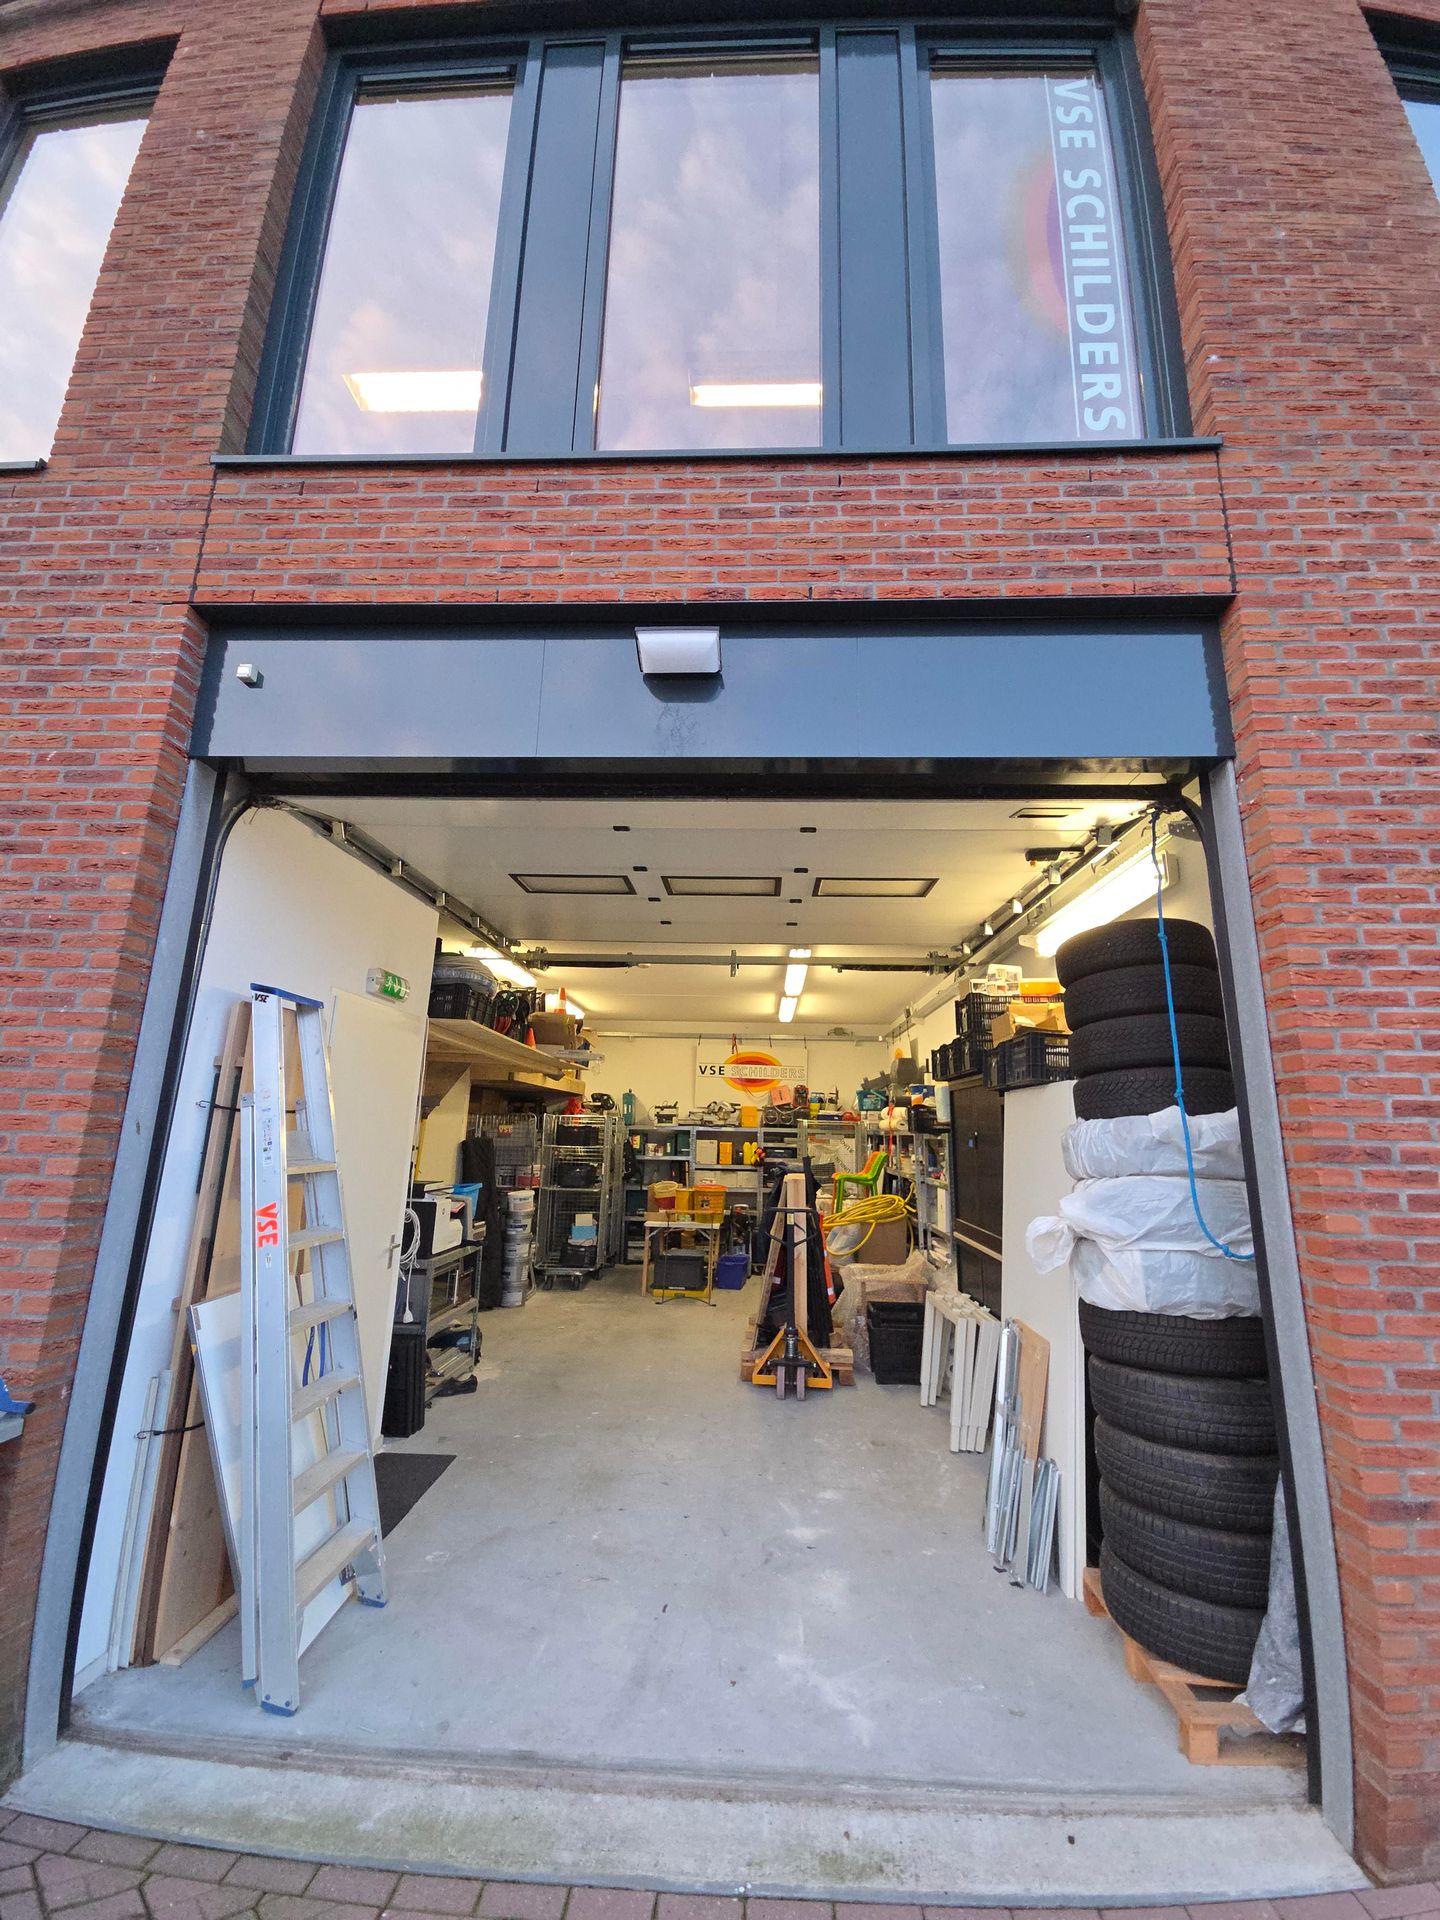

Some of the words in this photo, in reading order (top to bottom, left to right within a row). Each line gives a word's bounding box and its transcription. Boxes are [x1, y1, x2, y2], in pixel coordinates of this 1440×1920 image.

[1054, 78, 1097, 149] VSE
[1063, 168, 1127, 432] SCHILDERS
[254, 993, 269, 1003] VSE
[699, 1065, 725, 1076] VSE
[731, 1065, 805, 1078] SCHILDERS
[256, 1202, 279, 1248] VSE
